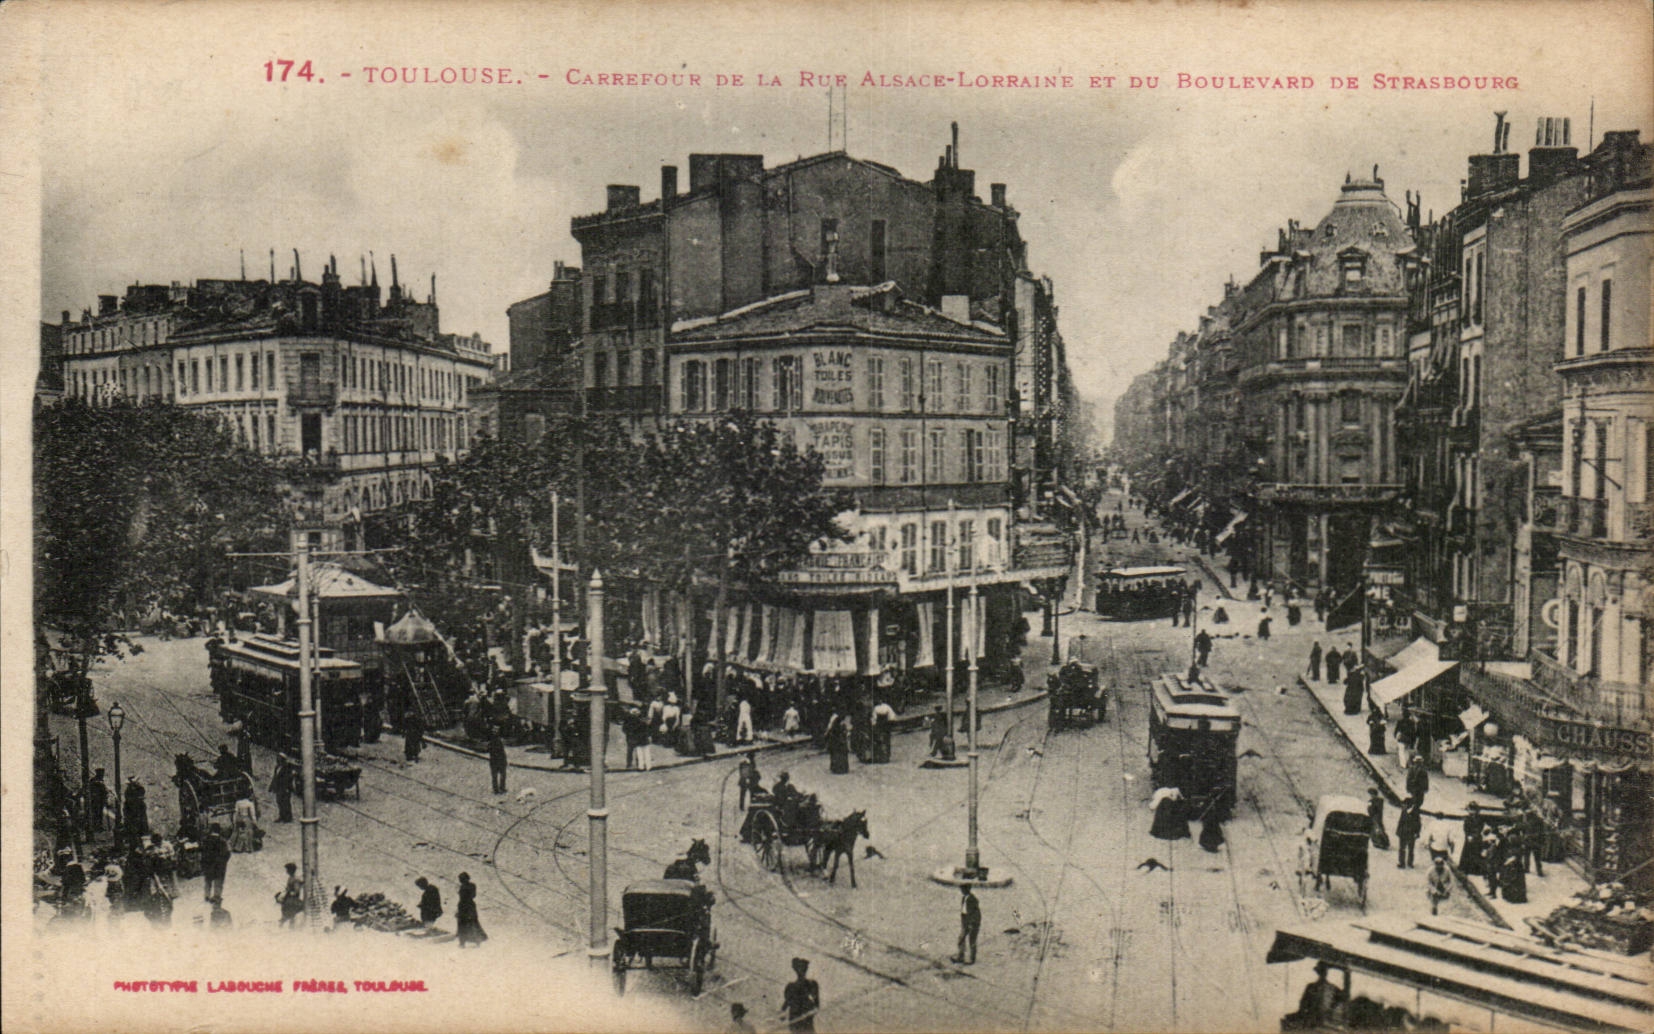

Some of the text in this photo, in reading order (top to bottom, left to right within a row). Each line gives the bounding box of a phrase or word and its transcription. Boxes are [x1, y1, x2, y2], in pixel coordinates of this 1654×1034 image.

[813, 350, 853, 368] BLANC
[815, 370, 852, 382] TOILES
[813, 434, 853, 448] TAPIS
